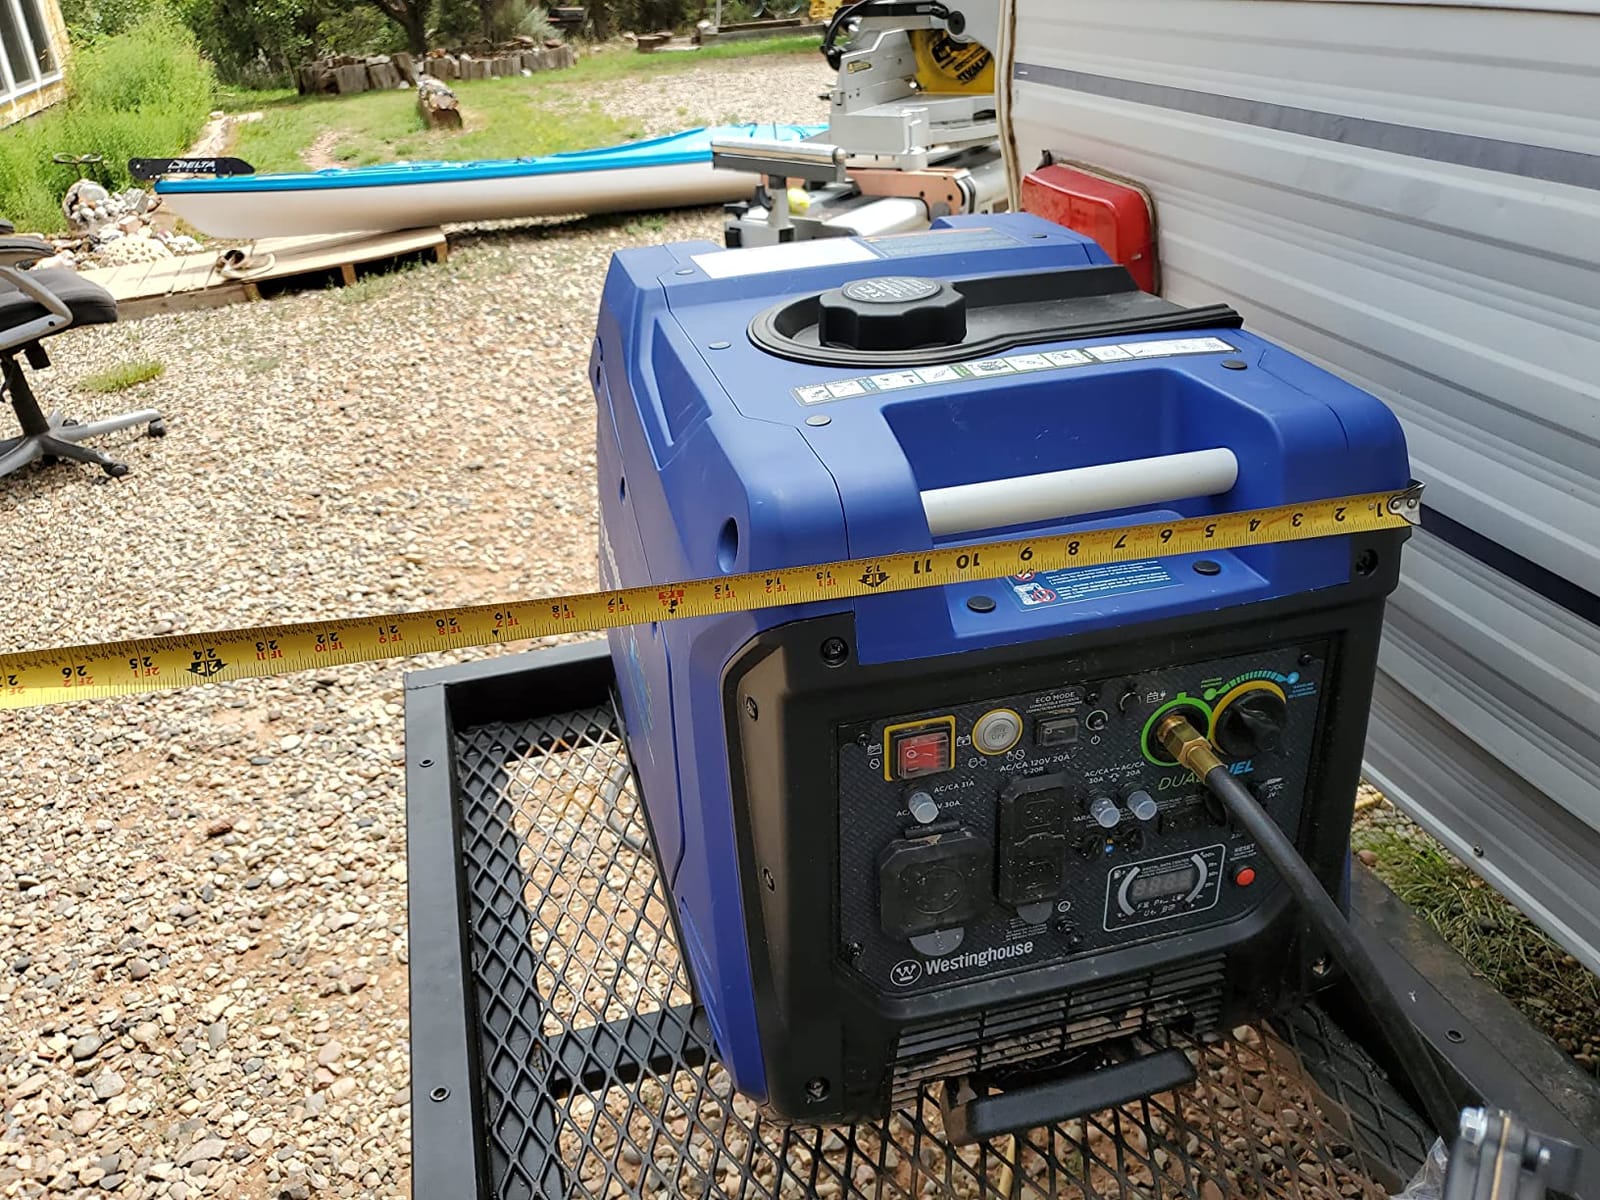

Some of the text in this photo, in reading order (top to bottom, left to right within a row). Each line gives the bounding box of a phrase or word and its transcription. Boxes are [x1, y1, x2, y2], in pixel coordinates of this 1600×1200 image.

[168, 160, 216, 169] DELTA
[1334, 507, 1346, 522] 2
[1375, 502, 1384, 517] 1
[1250, 518, 1261, 532] 4
[1292, 513, 1304, 527] 3
[1160, 529, 1172, 543] 6
[1205, 524, 1217, 537] 5
[1067, 541, 1080, 555] 8
[1114, 534, 1127, 549] 7
[956, 552, 980, 569] 10
[1020, 546, 1033, 561] 9
[913, 559, 932, 574] 11
[1035, 695, 1052, 704] ECO
[1053, 691, 1075, 700] MODE
[1000, 754, 1071, 772] AC/CA 120V 20A
[1120, 761, 1145, 771] AC/CA
[1084, 768, 1110, 778] AC/CA
[934, 783, 959, 794] AC/CA
[926, 940, 1033, 975] Westinghouse
